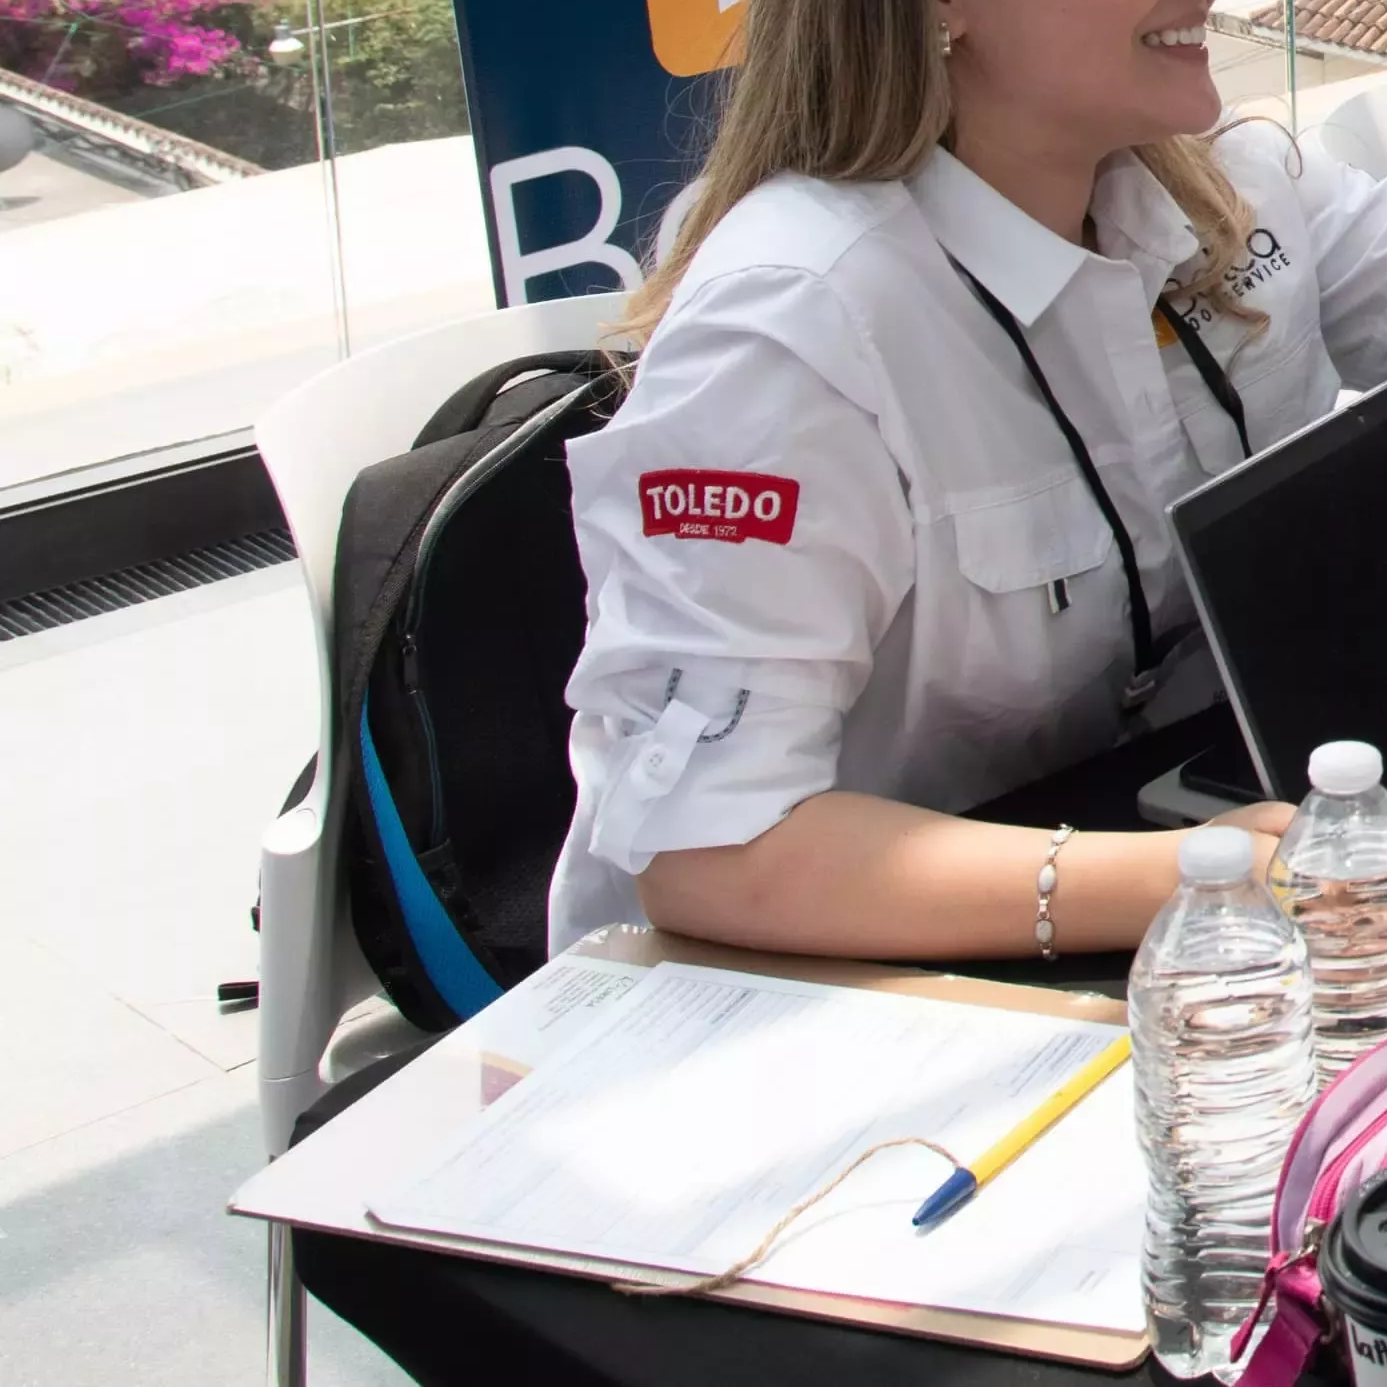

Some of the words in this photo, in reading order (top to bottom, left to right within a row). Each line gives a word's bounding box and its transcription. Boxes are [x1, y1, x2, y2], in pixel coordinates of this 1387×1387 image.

[1231, 252, 1291, 298] ERVICE
[646, 483, 781, 521] TOLEDO
[680, 522, 710, 535] DESDE
